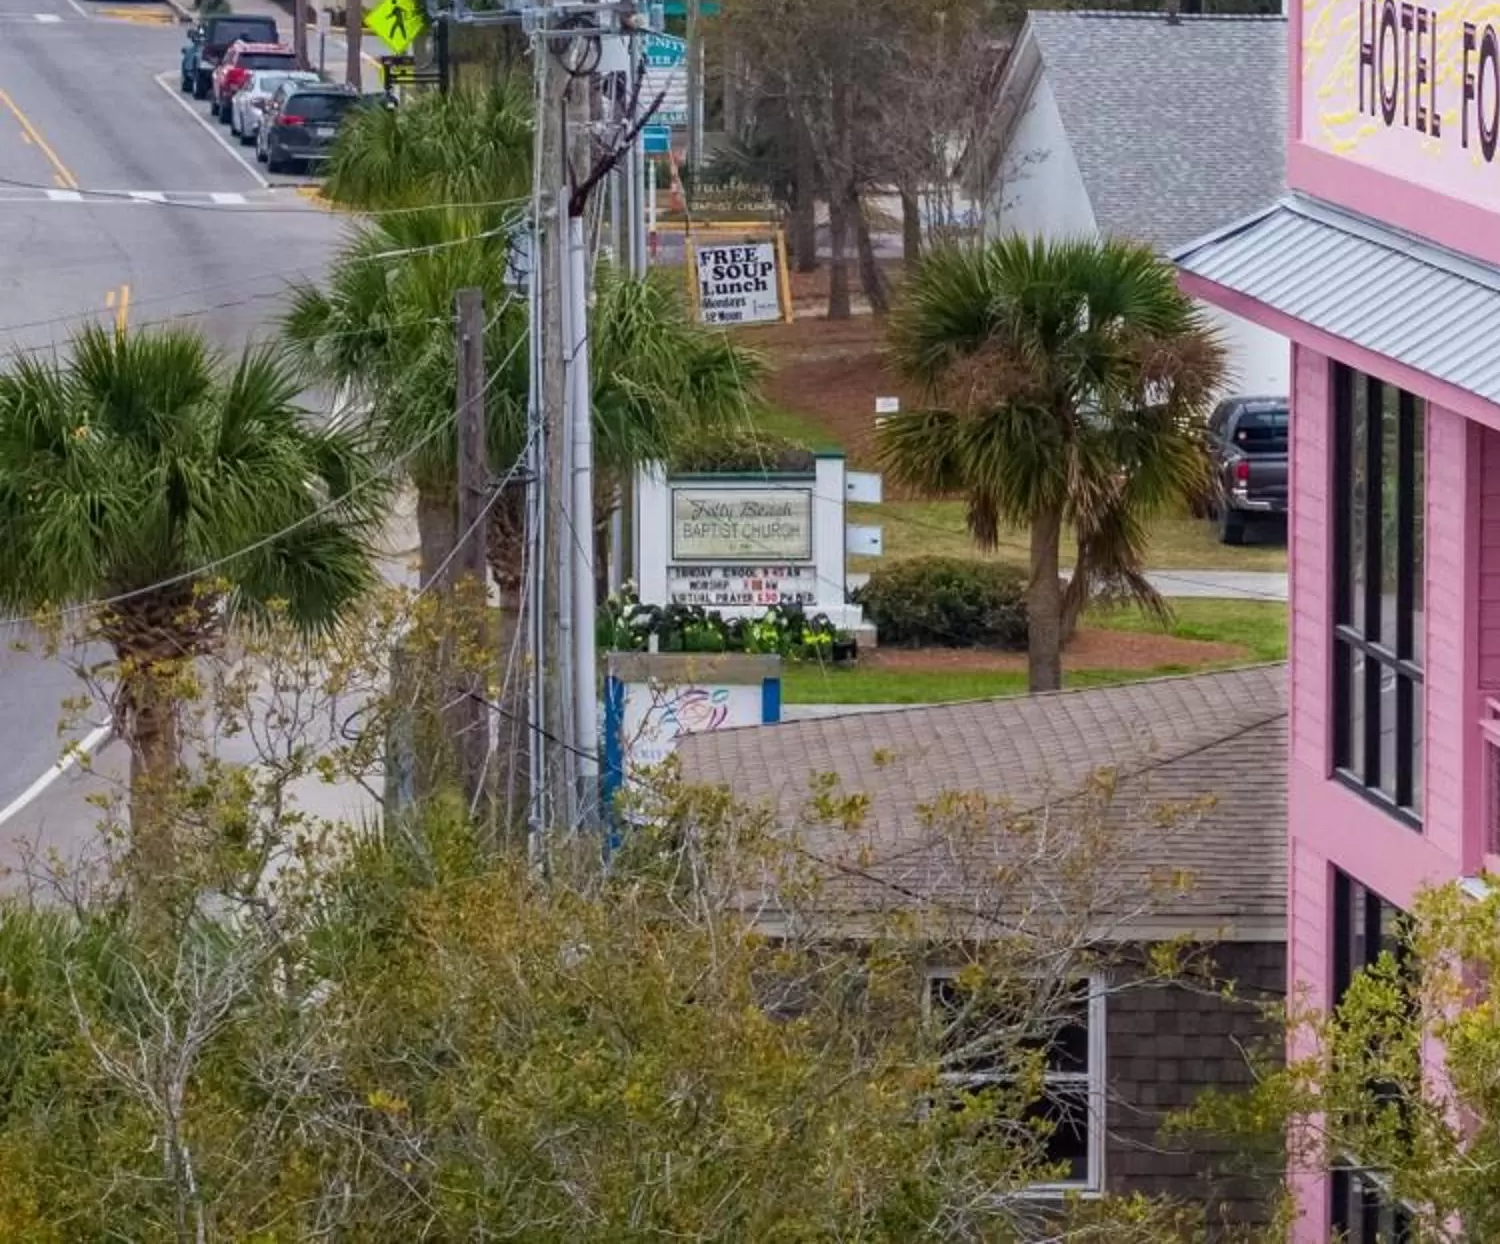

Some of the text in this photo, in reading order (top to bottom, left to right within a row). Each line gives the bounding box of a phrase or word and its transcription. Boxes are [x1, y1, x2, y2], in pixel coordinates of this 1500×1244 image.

[700, 247, 758, 267] FREE
[712, 261, 773, 281] SOUP
[702, 277, 768, 297] Lunch
[740, 500, 793, 517] Beach
[682, 522, 800, 539] BAPTIST CHURCH
